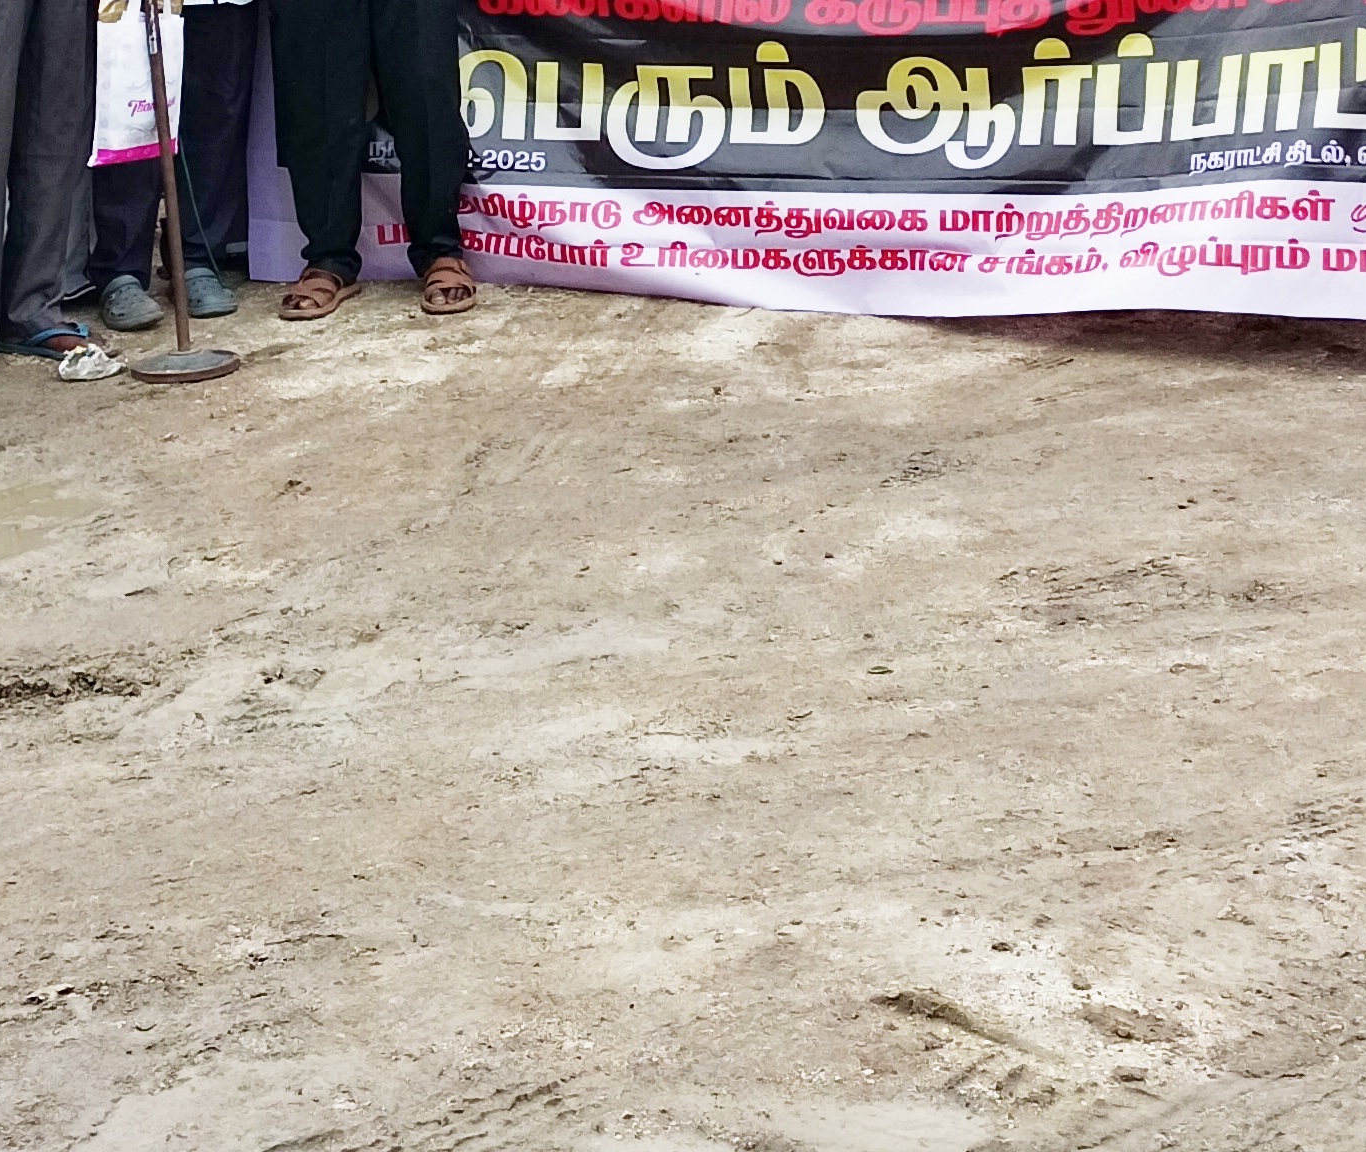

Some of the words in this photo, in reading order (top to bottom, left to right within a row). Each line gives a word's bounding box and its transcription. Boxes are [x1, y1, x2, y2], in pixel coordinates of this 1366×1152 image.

[1189, 141, 1281, 177] நகராட்சி
[1284, 139, 1351, 168] திடல்,
[633, 200, 929, 238] அனைத்துவகை
[939, 189, 1336, 242] மாற்றுத்திறனாளிகள்
[620, 240, 972, 277] உரிமைகளுக்கான
[977, 246, 1109, 276] சங்கம்,
[1119, 236, 1311, 277] விழுப்புரம்
